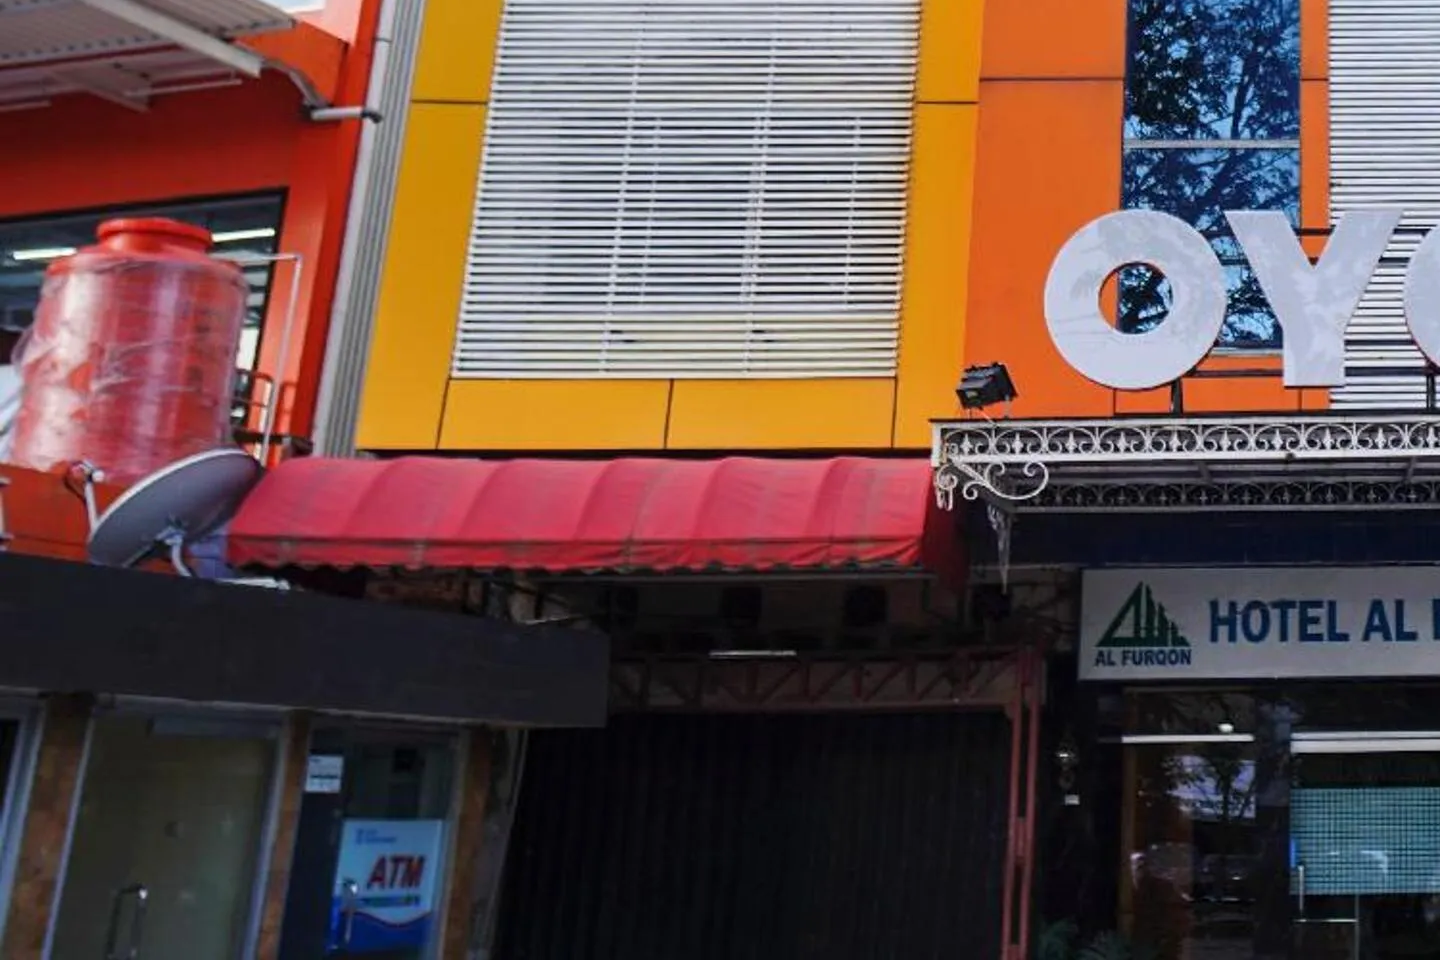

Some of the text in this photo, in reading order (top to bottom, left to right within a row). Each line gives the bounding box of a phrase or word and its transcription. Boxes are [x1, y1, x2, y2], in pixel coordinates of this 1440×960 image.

[1208, 598, 1349, 643] HOTEL
[1362, 598, 1418, 642] AL
[1095, 648, 1192, 667] AL FURQON
[366, 853, 425, 890] ATM
